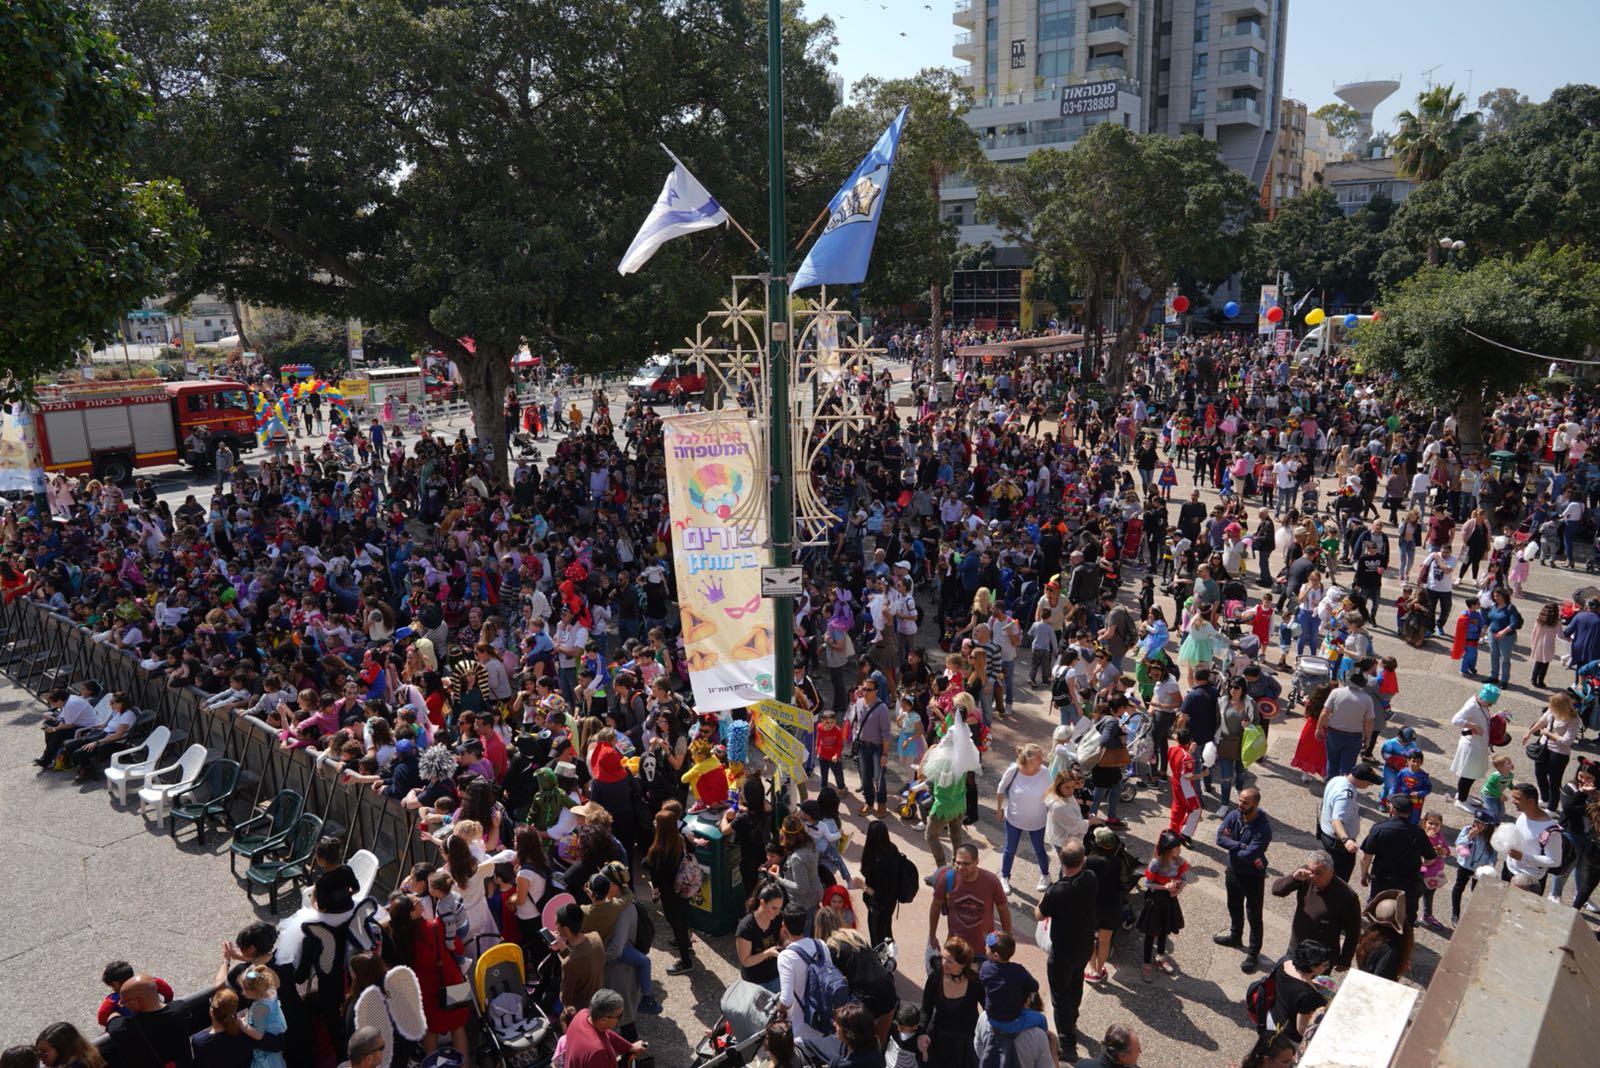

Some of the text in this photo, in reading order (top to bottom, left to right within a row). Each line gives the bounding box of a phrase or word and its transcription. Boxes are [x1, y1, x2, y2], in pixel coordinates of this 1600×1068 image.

[1064, 82, 1116, 100] פנטהאוז
[1063, 96, 1115, 114] 03-6738888
[85, 398, 122, 407] כבאות
[131, 394, 168, 403] שירותי
[674, 443, 749, 459] המשפחה
[682, 527, 757, 550] פורים
